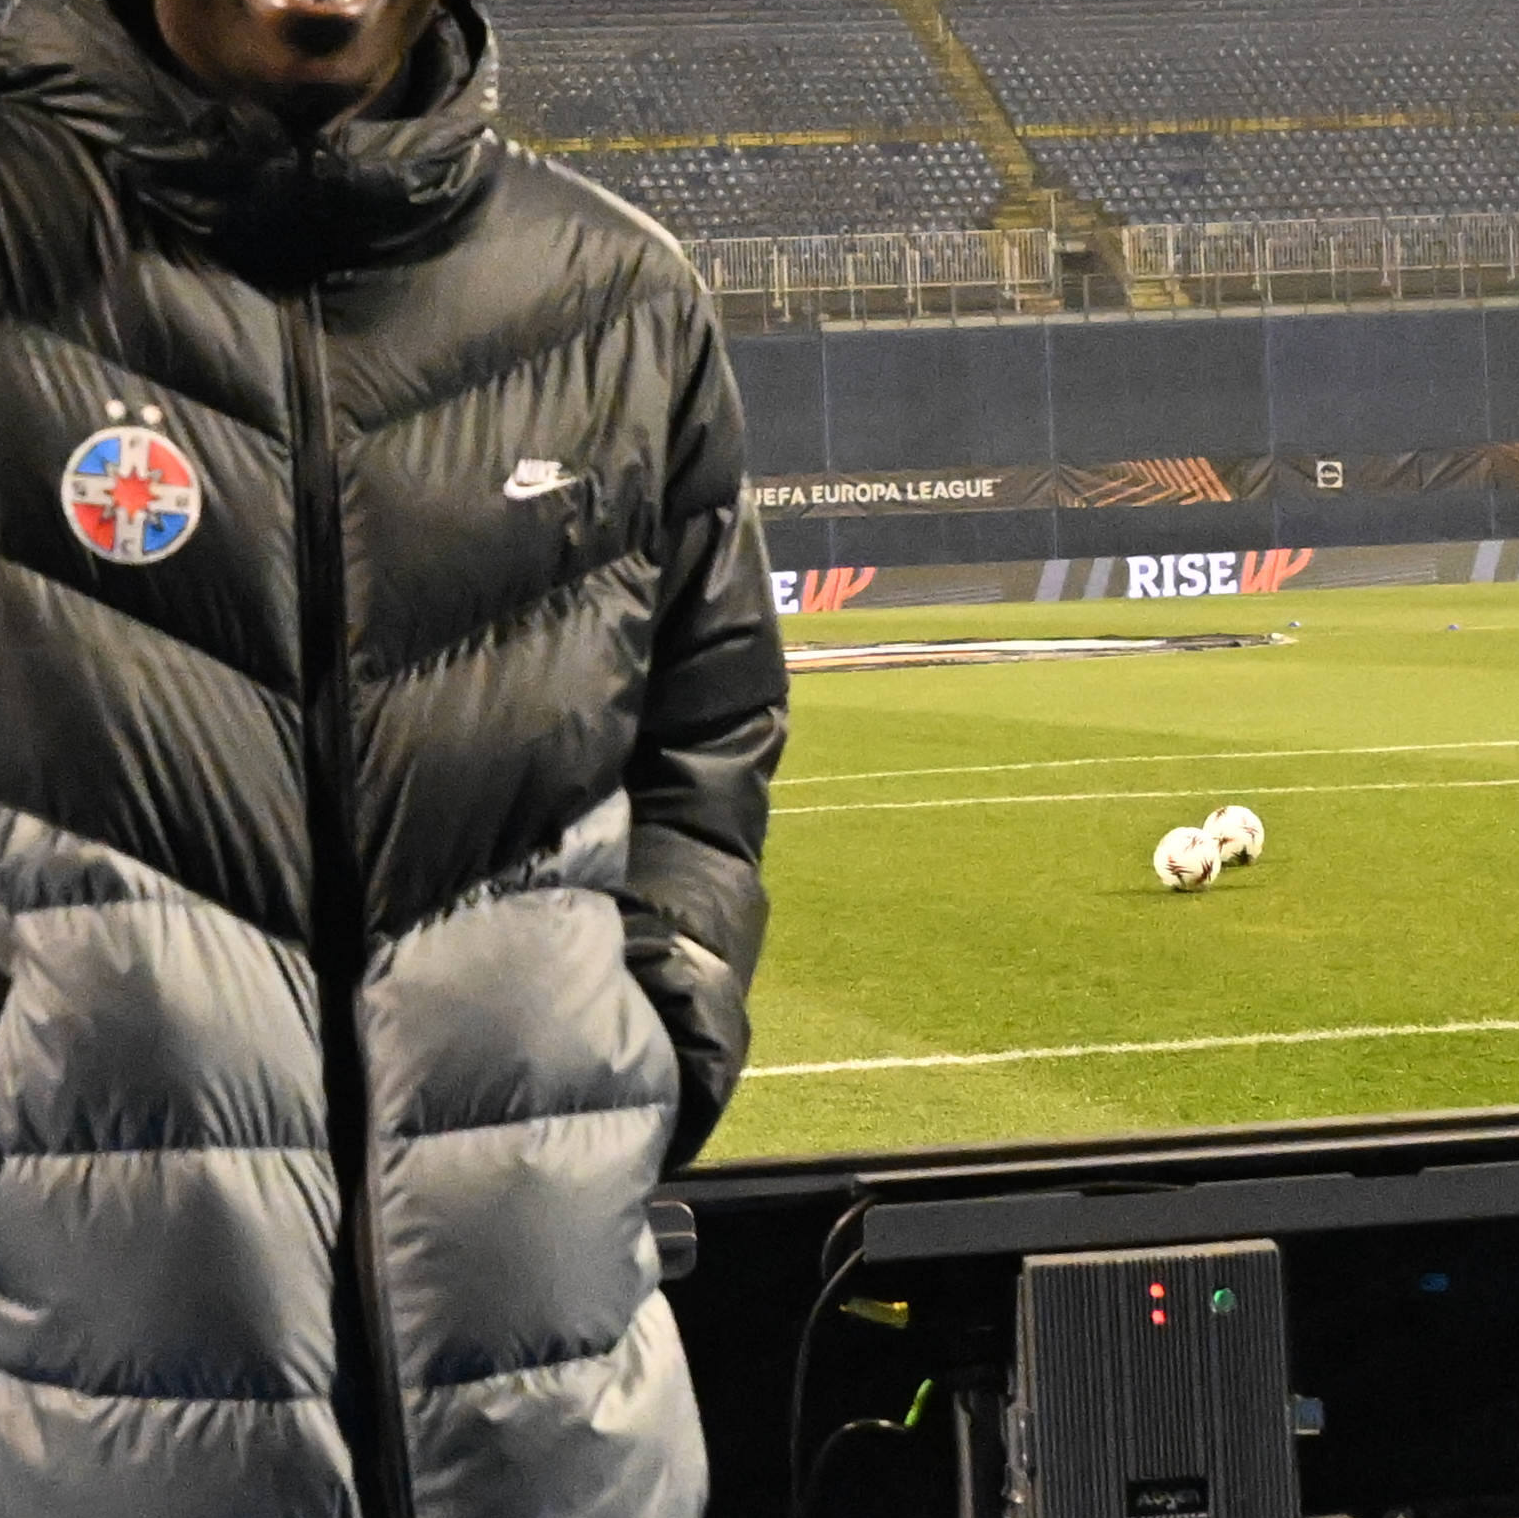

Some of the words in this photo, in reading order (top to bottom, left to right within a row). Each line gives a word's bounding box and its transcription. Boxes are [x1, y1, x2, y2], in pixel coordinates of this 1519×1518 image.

[810, 482, 903, 503] EUROPA
[906, 478, 995, 500] LEAGUE
[801, 566, 878, 613] UP
[1126, 551, 1239, 599] RISE
[1239, 548, 1314, 594] UP
